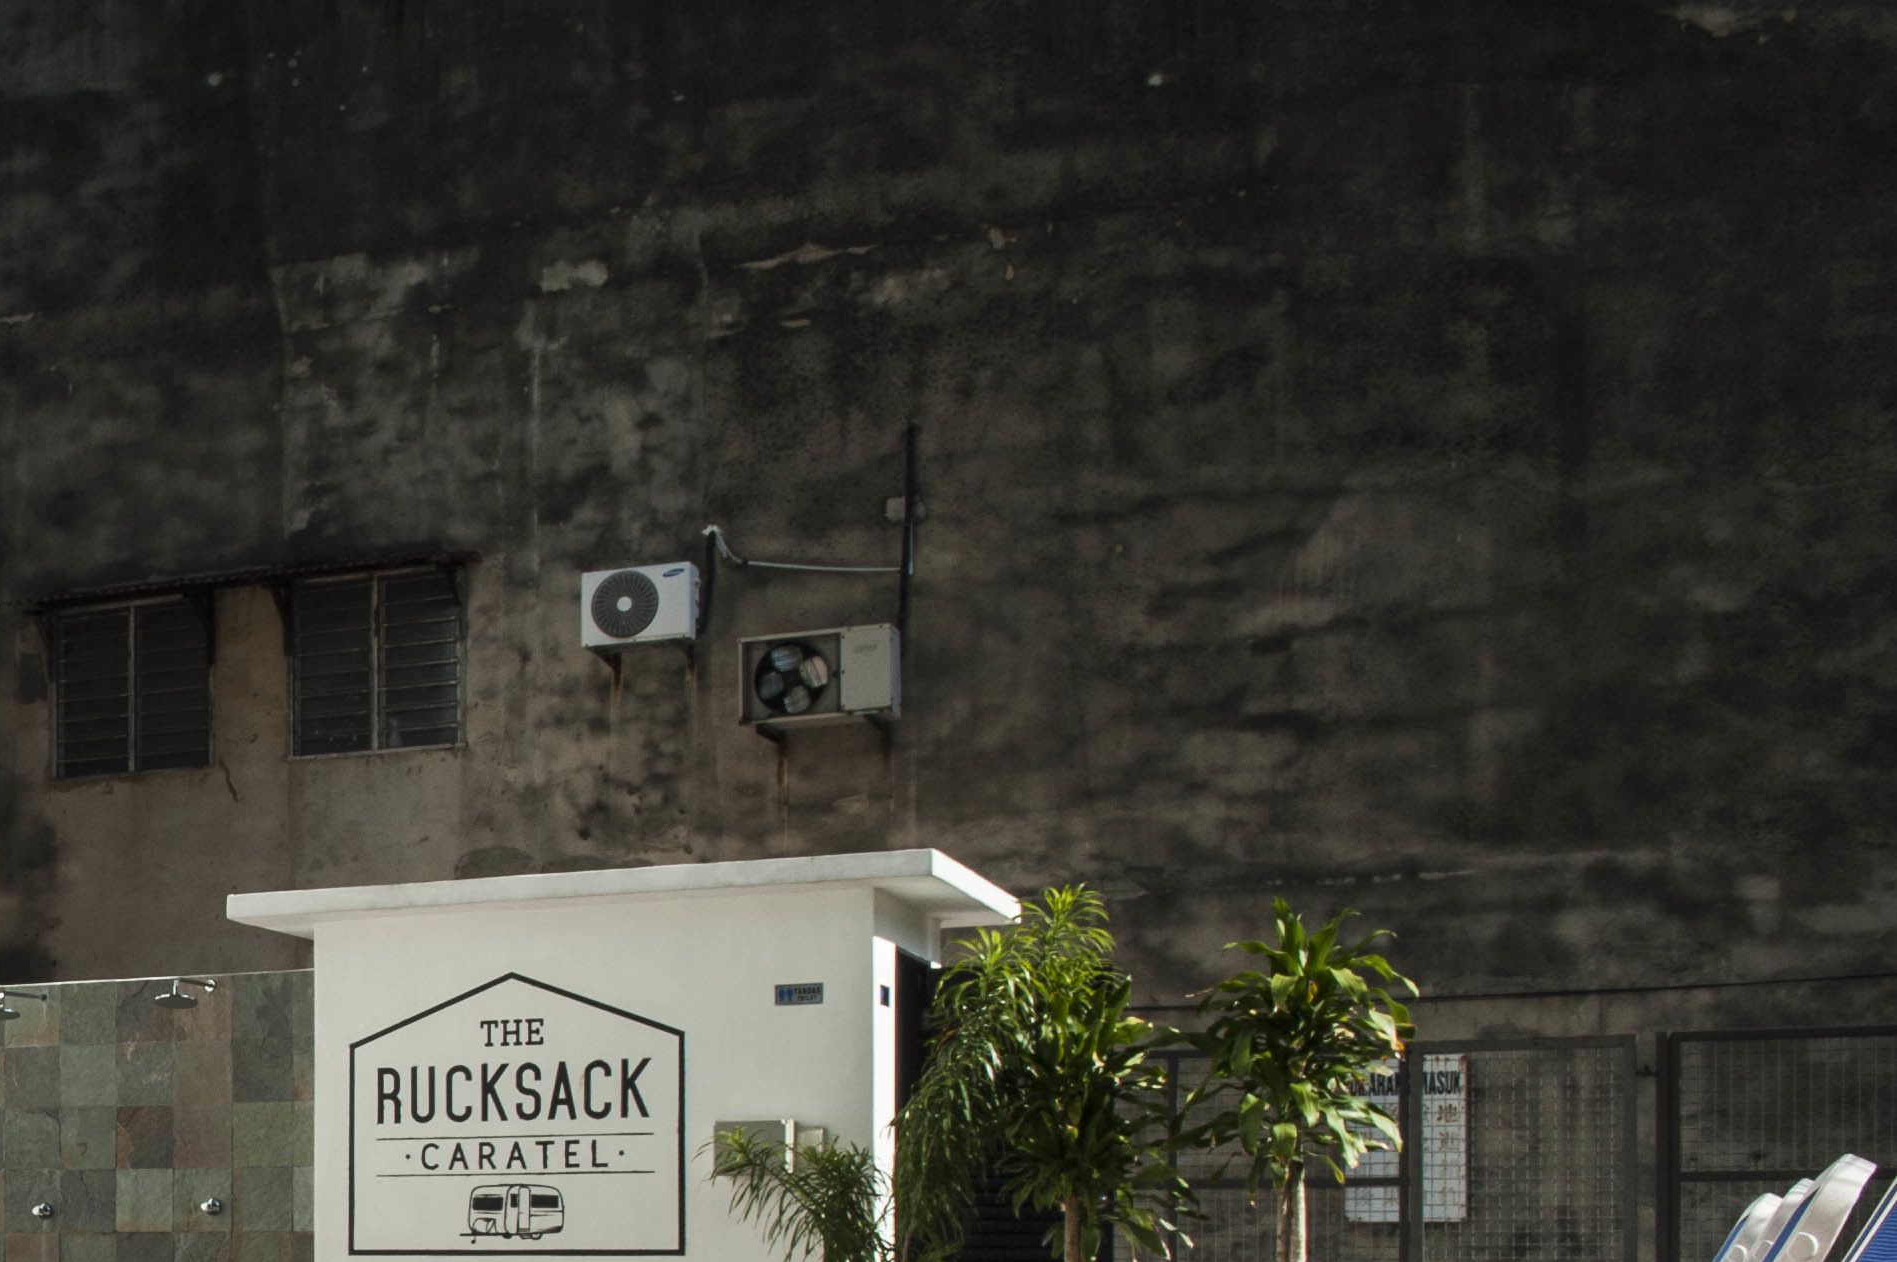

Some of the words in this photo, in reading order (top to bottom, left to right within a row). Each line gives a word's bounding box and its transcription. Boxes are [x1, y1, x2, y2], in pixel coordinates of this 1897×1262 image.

[480, 1018, 545, 1048] THE
[377, 1057, 653, 1125] RUCKSACK
[421, 1139, 609, 1171] CARATEL
